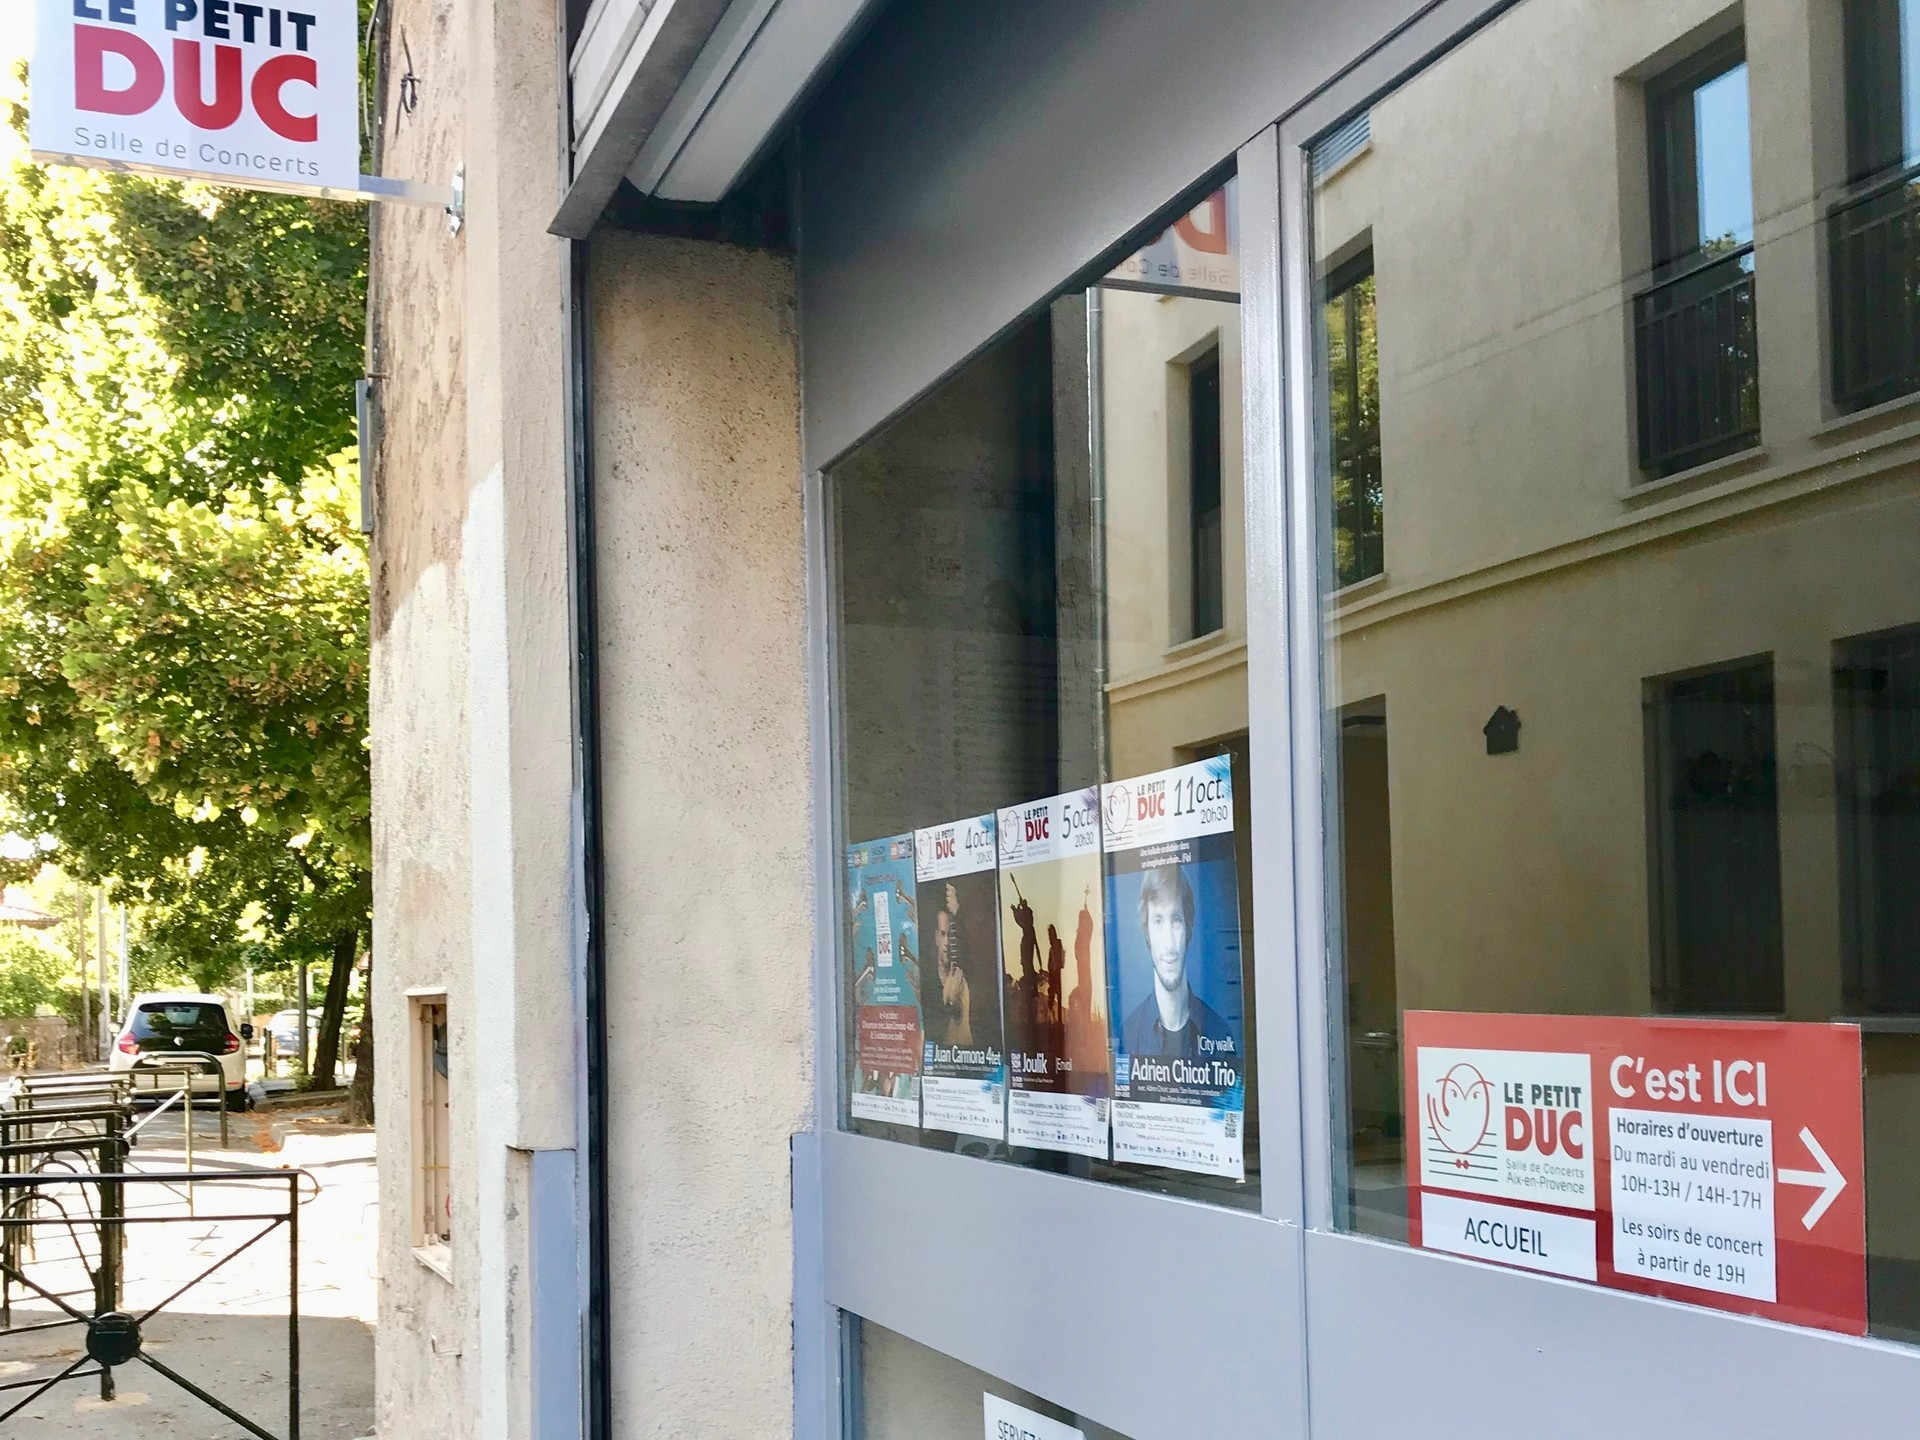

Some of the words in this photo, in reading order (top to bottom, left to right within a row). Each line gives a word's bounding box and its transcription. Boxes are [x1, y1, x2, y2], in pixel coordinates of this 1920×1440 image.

[74, 0, 136, 25] LE
[164, 0, 317, 52] PETIT
[73, 24, 318, 143] DUC
[75, 127, 142, 154] Salle
[155, 139, 188, 161] de
[198, 144, 320, 177] Concerts
[1147, 779, 1166, 796] PETIT
[1032, 806, 1049, 819] PETIT
[1137, 793, 1166, 820] DUC
[1200, 805, 1229, 825] 20h30
[1025, 816, 1050, 842] DUC
[936, 838, 955, 860] DUC
[934, 1044, 951, 1063] Juan
[952, 1045, 985, 1065] Carmona
[1216, 1038, 1235, 1052] walk
[1131, 1058, 1170, 1083] Adrien
[1172, 1059, 1211, 1085] Chicot
[1212, 1062, 1236, 1087] Trio
[1608, 1055, 1703, 1104] C'est
[1713, 1060, 1767, 1107] ICI
[1504, 1082, 1524, 1105] LE
[1531, 1084, 1582, 1109] PETIT
[1505, 1106, 1584, 1160] DUC
[1616, 1117, 1674, 1140] Horaires
[1676, 1121, 1764, 1149] d'ouverture
[1505, 1159, 1528, 1171] Salle
[1529, 1162, 1541, 1173] de
[1542, 1163, 1585, 1179] Concerts
[1613, 1146, 1633, 1163] Du
[1635, 1147, 1676, 1169] mardi
[1680, 1156, 1697, 1171] au
[1702, 1157, 1770, 1180] vendredi
[1506, 1172, 1585, 1194] Aix-en-Provence
[1620, 1175, 1681, 1200] 10H-13H
[1696, 1185, 1762, 1211] 14H-17H
[1464, 1217, 1548, 1258] ACCUEIL
[1621, 1217, 1644, 1237] Les
[1646, 1223, 1680, 1242] soirs
[1684, 1227, 1702, 1247] de
[1705, 1234, 1764, 1257] concert
[1637, 1247, 1646, 1267] à
[1649, 1249, 1689, 1275] partir
[1693, 1259, 1712, 1279] de
[1715, 1262, 1745, 1285] 19H
